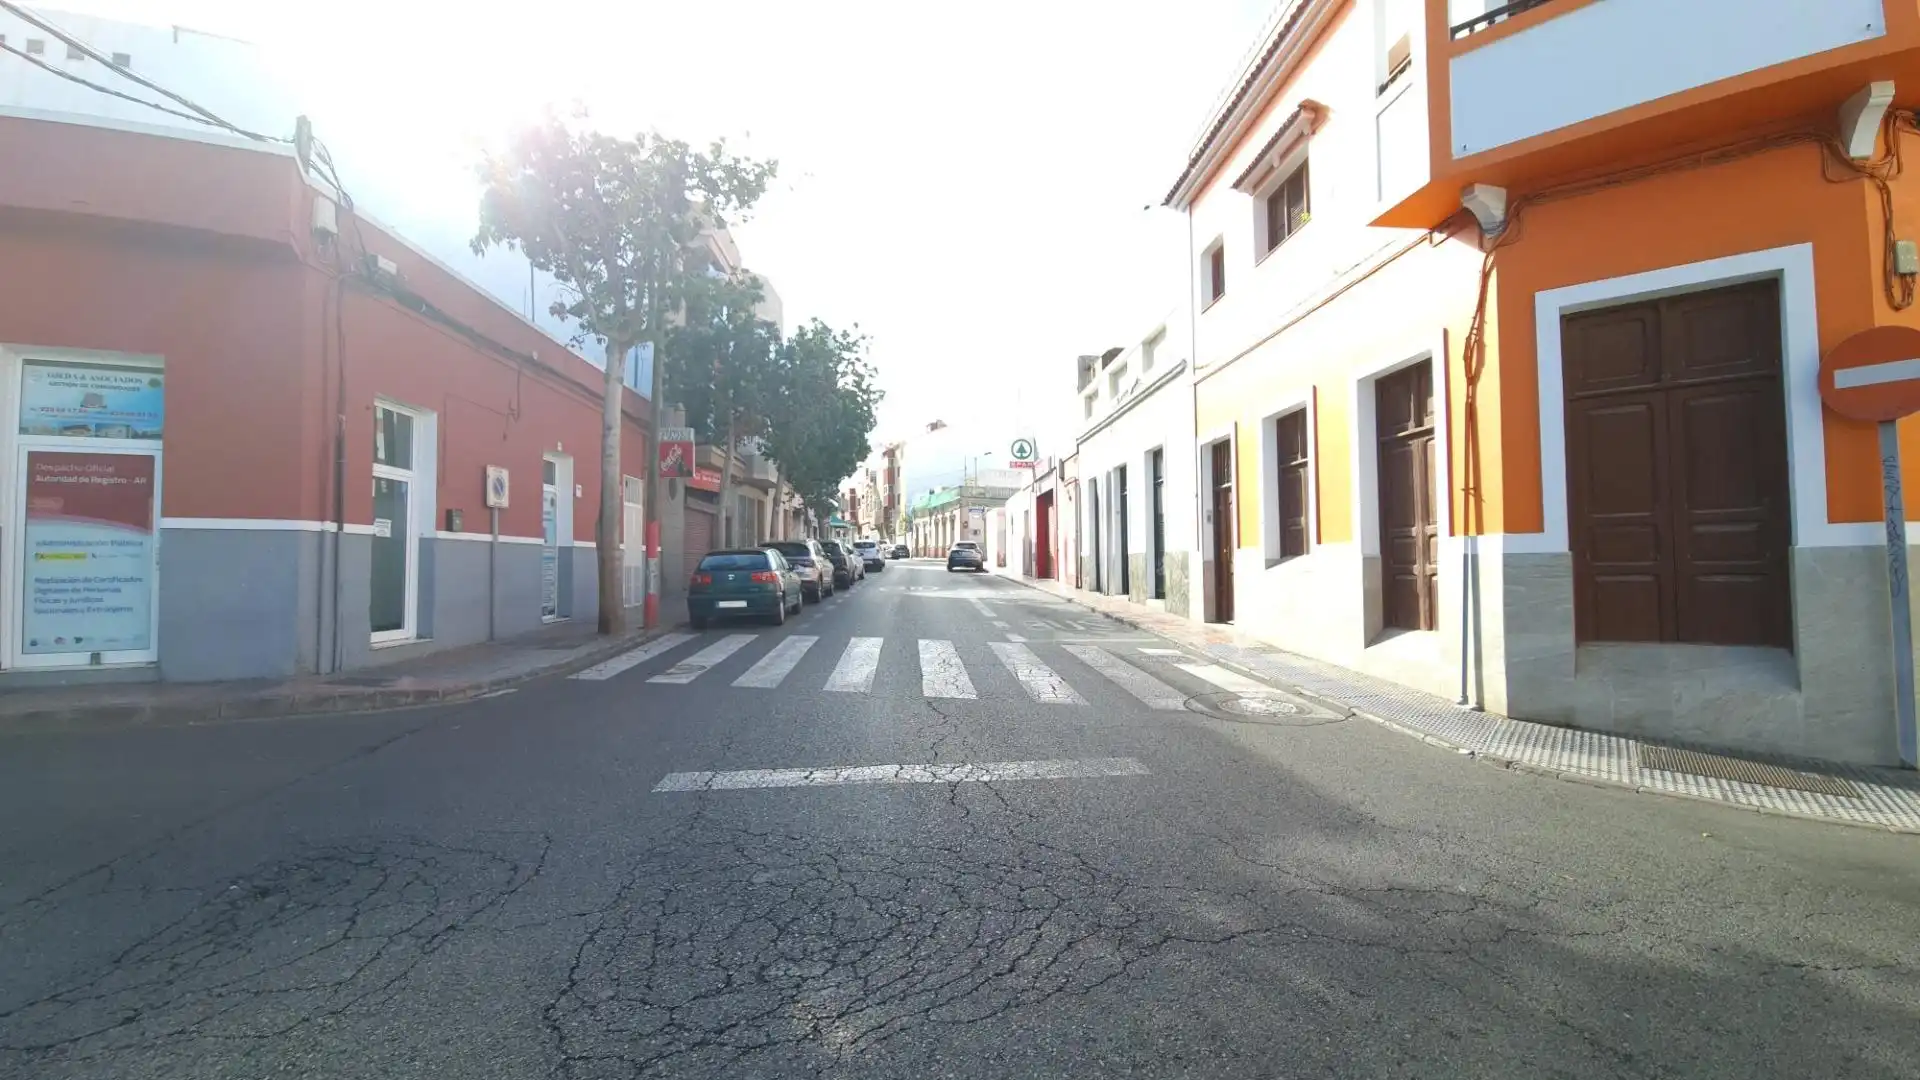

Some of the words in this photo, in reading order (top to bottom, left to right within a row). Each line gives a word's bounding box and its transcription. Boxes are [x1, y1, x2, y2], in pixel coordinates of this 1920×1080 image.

[35, 463, 85, 473] Despacho
[86, 464, 115, 474] Oficial
[35, 474, 78, 483] Autoridad
[79, 475, 90, 483] de
[91, 475, 127, 485] Registro
[94, 576, 143, 584] Certificados
[83, 586, 122, 594] Personas
